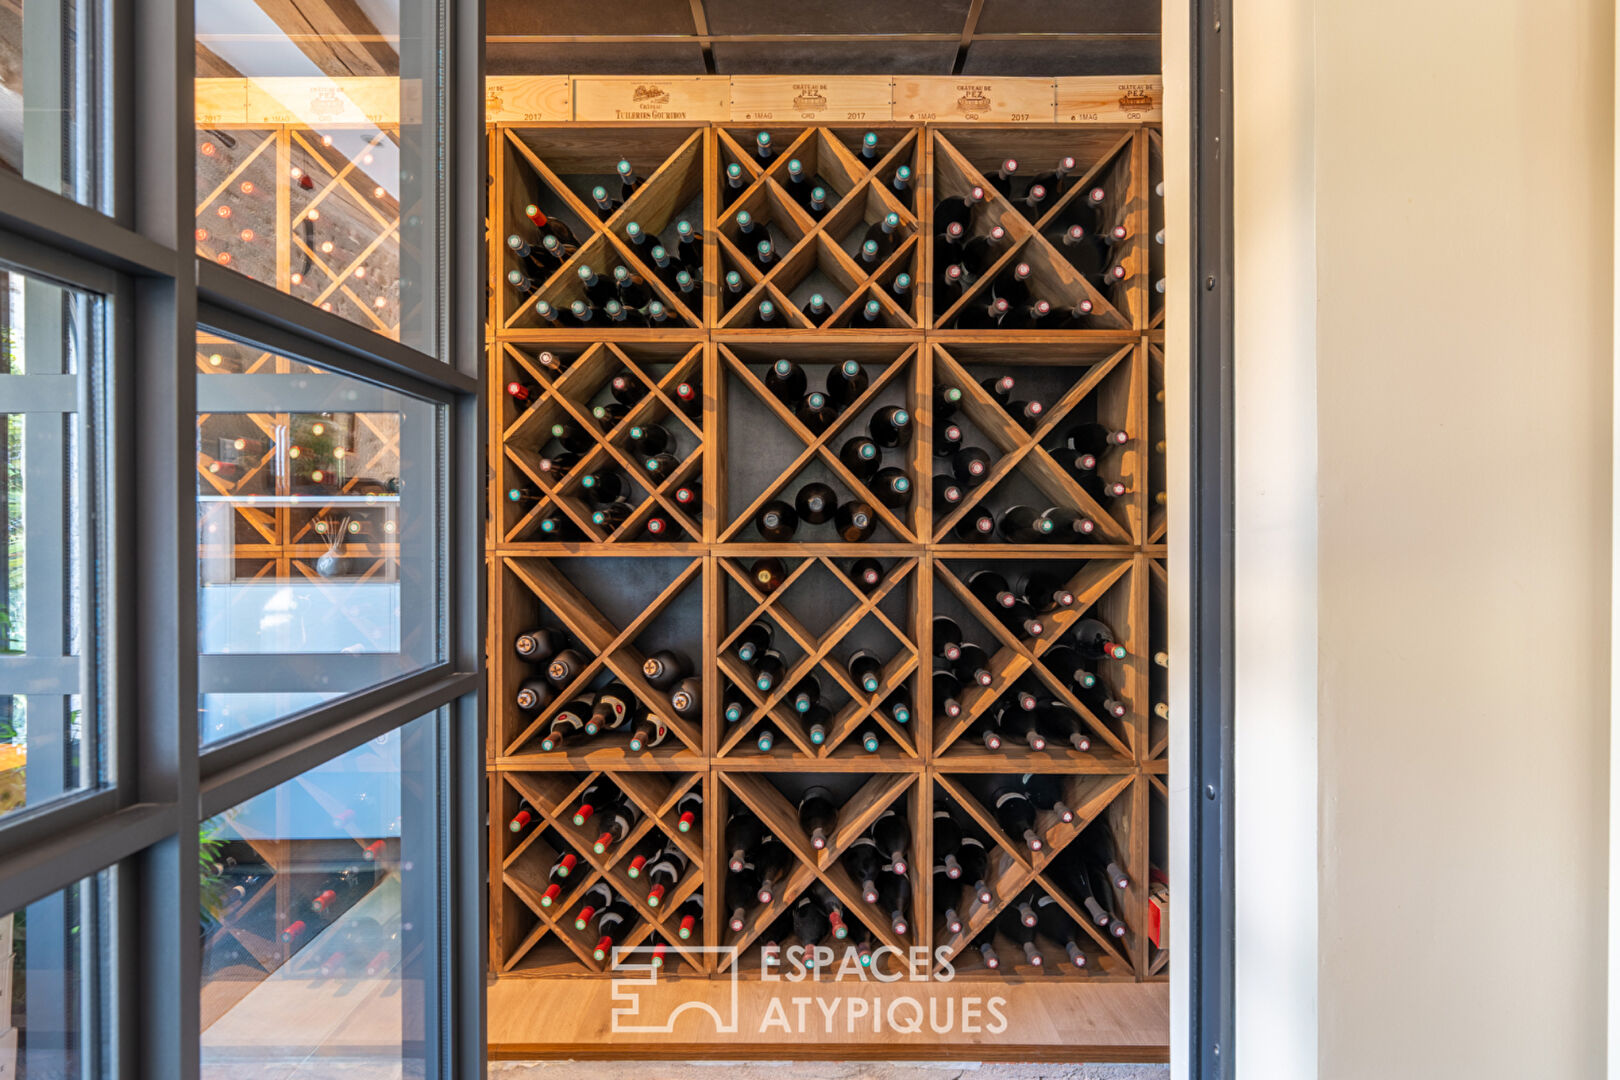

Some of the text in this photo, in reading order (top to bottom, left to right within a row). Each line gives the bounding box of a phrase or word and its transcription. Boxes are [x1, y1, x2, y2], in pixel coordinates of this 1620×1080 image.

[524, 113, 542, 121] 2017
[847, 112, 866, 120] 2017
[1011, 113, 1029, 121] 2017
